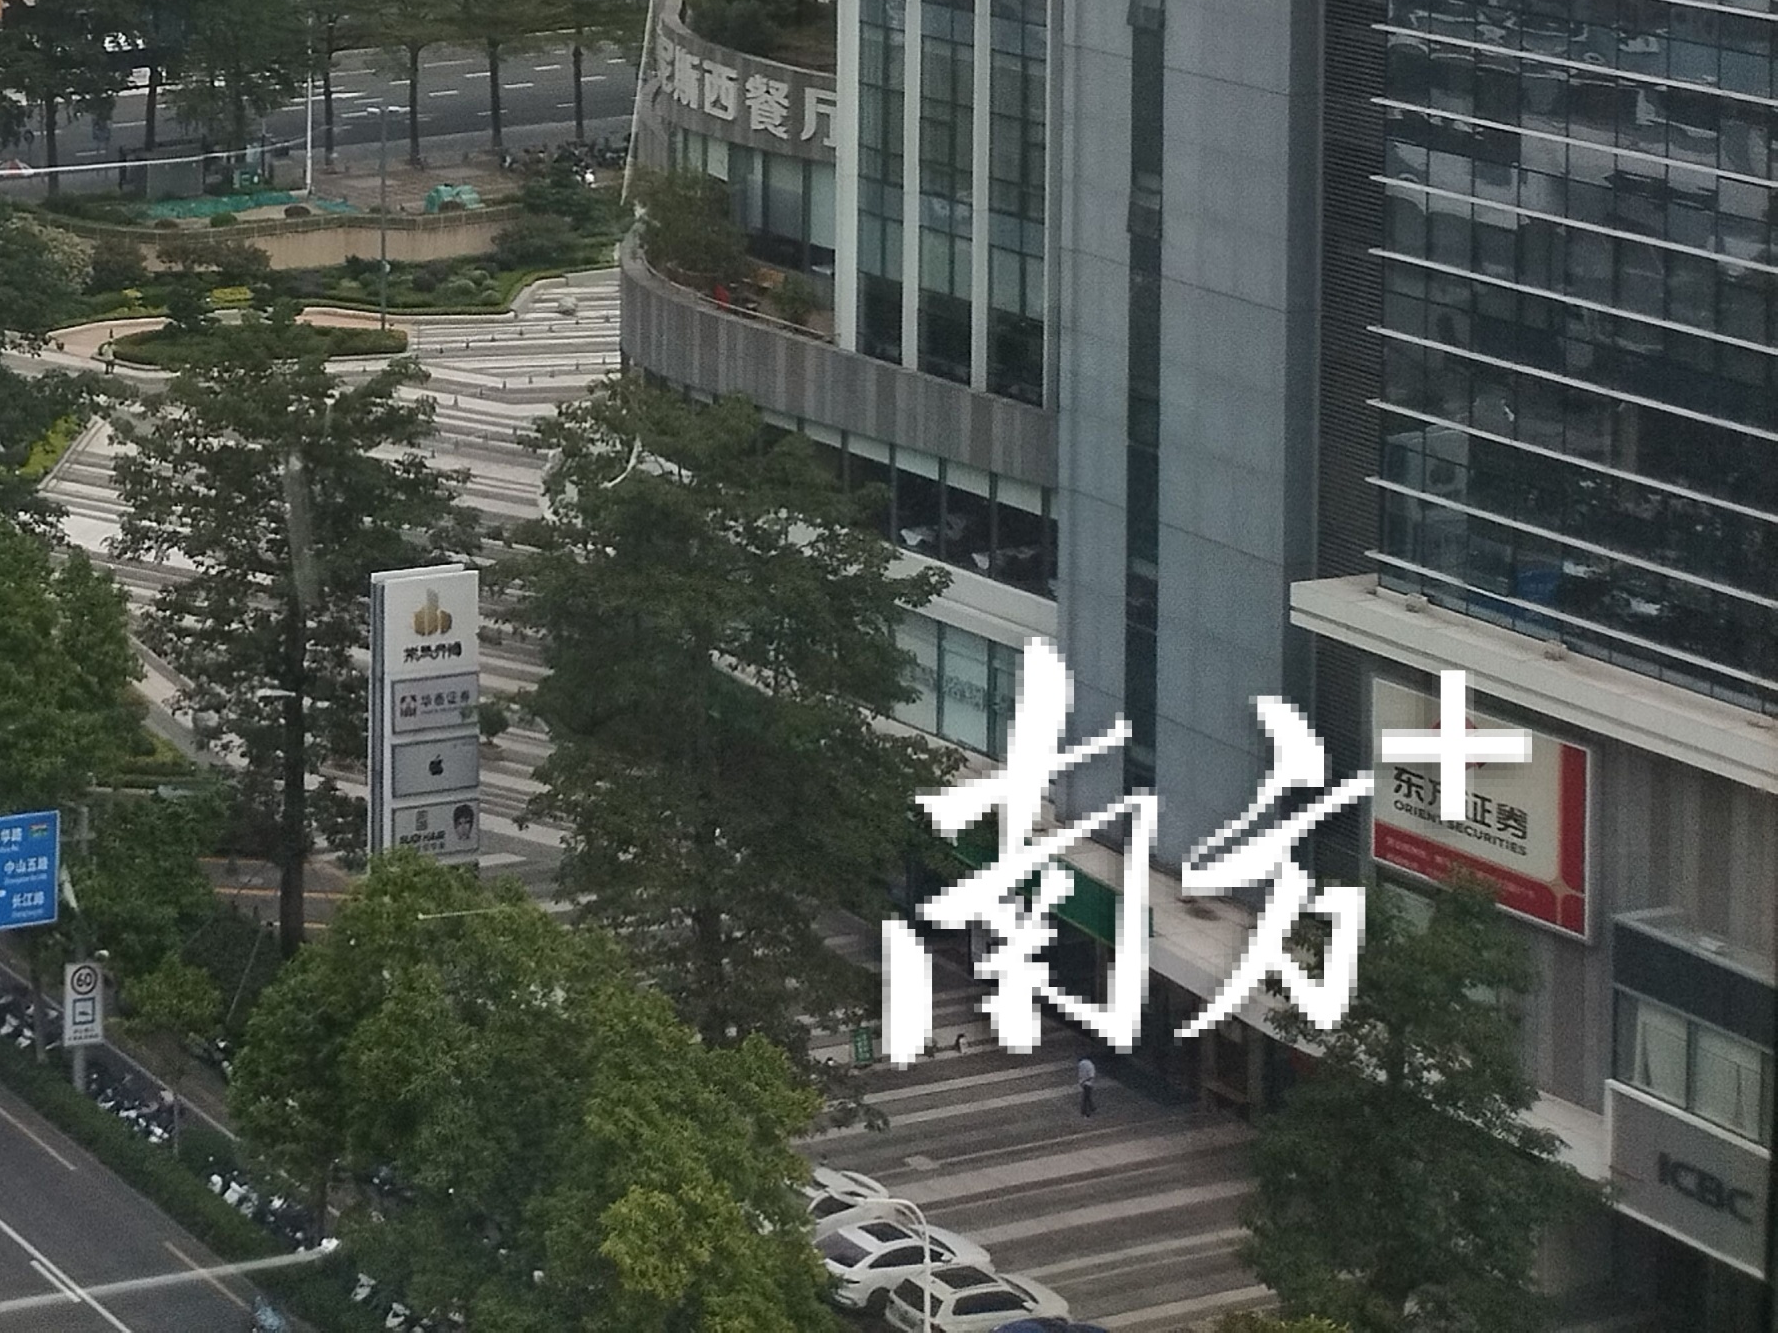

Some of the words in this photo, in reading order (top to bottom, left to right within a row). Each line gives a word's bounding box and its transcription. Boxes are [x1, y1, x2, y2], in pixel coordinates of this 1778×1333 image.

[1447, 820, 1528, 856] SECURITIES
[4, 856, 49, 874] 中山五路
[12, 891, 45, 908] 长江路
[76, 972, 93, 988] 60
[1658, 1151, 1755, 1226] ICBC
